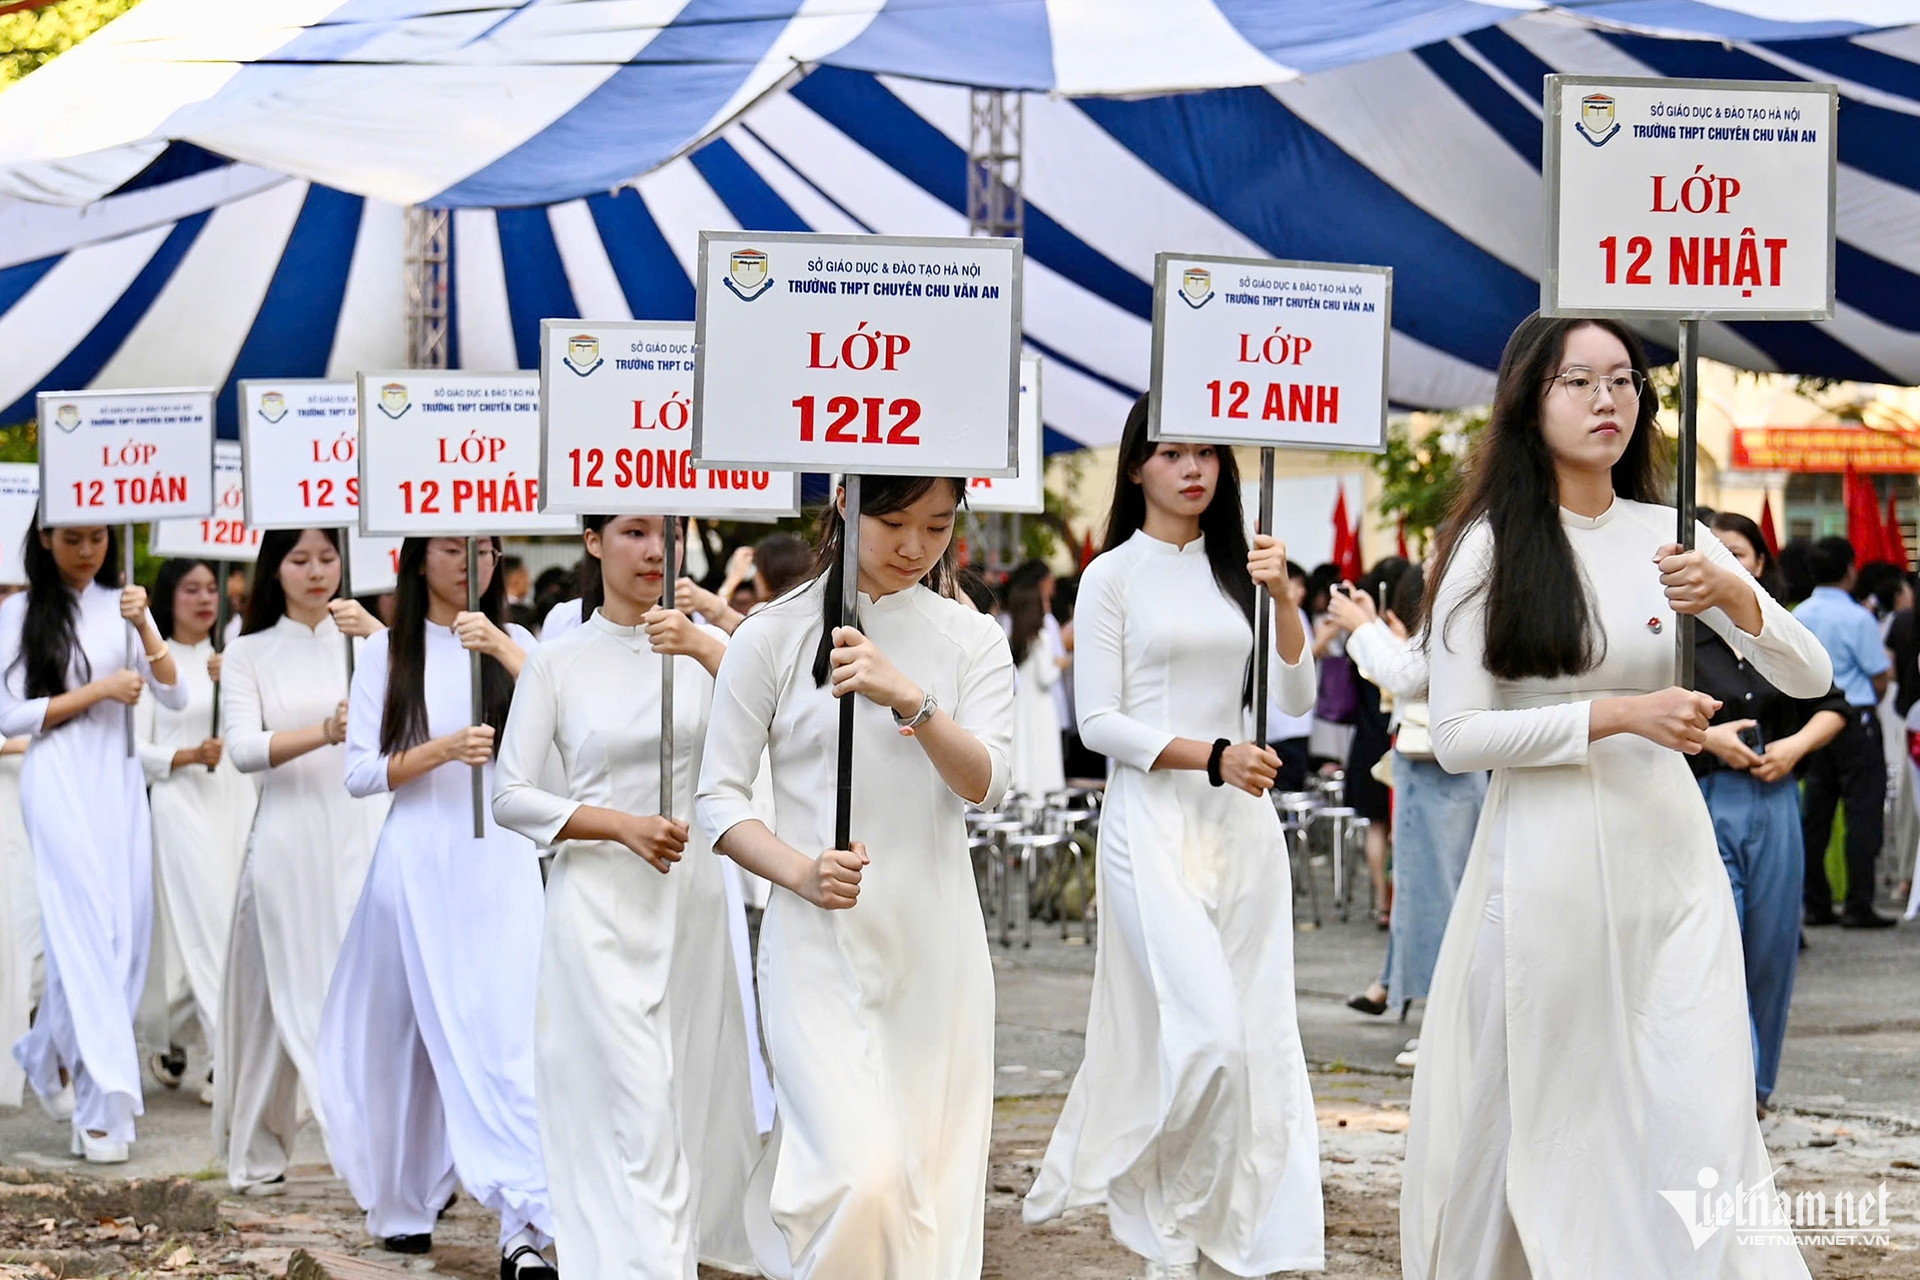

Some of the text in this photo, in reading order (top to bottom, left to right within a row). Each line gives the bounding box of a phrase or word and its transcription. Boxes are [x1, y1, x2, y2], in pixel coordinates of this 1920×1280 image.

[1650, 101, 1800, 123] SỞ GIÁO DỤC & ĐÀO TẠO HÀ NỘI
[1633, 122, 1816, 142] TRƯỜNG THPT CHUYÊN CHU VĂN AN
[1650, 165, 1741, 213] LỚP
[808, 257, 981, 279] SỞ GIÁO DỤC & ĐÀO TẠO HÀ NỘI
[1599, 227, 1787, 297] 12 NHẬT
[788, 278, 999, 299] TRƯỜNG THPT CHUYÊN CHU VĂN AN
[1252, 277, 1272, 289] GIÁO
[1273, 280, 1289, 292] DỤC
[1292, 281, 1297, 291] &
[1300, 280, 1316, 292] ĐÀO
[1336, 282, 1347, 294] HÀ
[1225, 292, 1259, 306] TRƯỜNG
[1262, 295, 1284, 307] THPT
[1286, 295, 1320, 309] CHUYÊN
[1323, 299, 1340, 310] CHU
[1362, 301, 1375, 313] AN
[631, 340, 643, 353] SỞ
[645, 342, 667, 354] GIÁO
[669, 344, 687, 355] DỤC
[806, 322, 911, 371] LỚP
[1237, 326, 1312, 366] LỚP
[615, 358, 654, 370] TRƯỜNG
[657, 360, 681, 371] THPT
[457, 403, 477, 412] THPT
[514, 403, 530, 412] CHU
[630, 391, 691, 430] LỚ
[1206, 380, 1339, 424] 12 ANH
[792, 395, 921, 445] 12I2
[103, 438, 157, 467] LỚP
[313, 430, 356, 462] LỚ
[438, 429, 506, 463] LỚP
[569, 448, 603, 487] 12
[615, 449, 697, 488] SONG
[72, 481, 105, 507] 12
[115, 471, 187, 505] TOÁN
[298, 479, 334, 507] 12
[398, 480, 440, 514] 12
[453, 472, 539, 513] PHÁP
